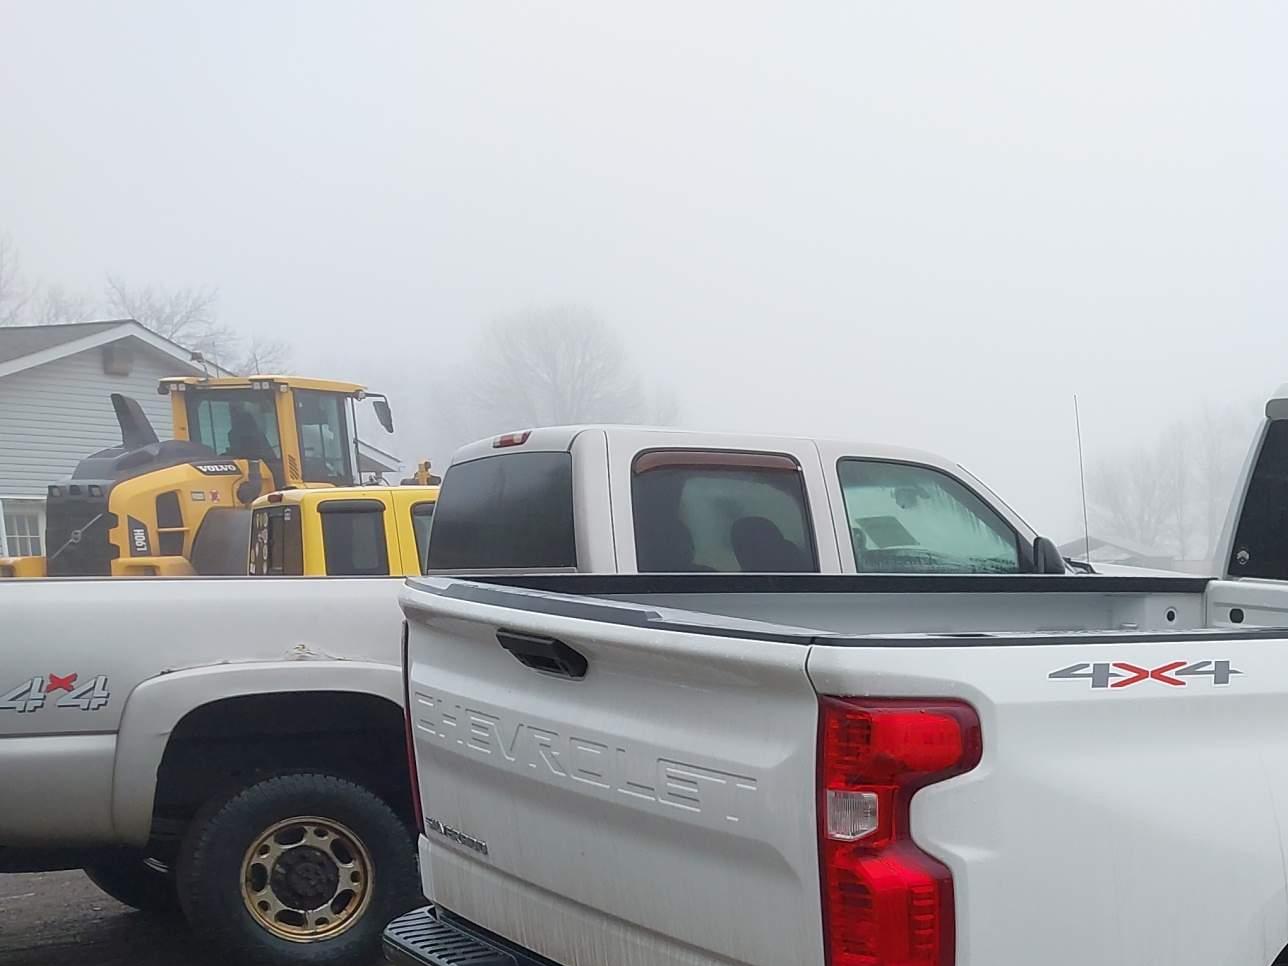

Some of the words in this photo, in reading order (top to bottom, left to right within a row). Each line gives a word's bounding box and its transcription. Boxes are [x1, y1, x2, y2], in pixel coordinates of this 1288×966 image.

[198, 464, 236, 472] VOLVO
[133, 528, 147, 551] L90H
[415, 692, 757, 821] CHEVROLET
